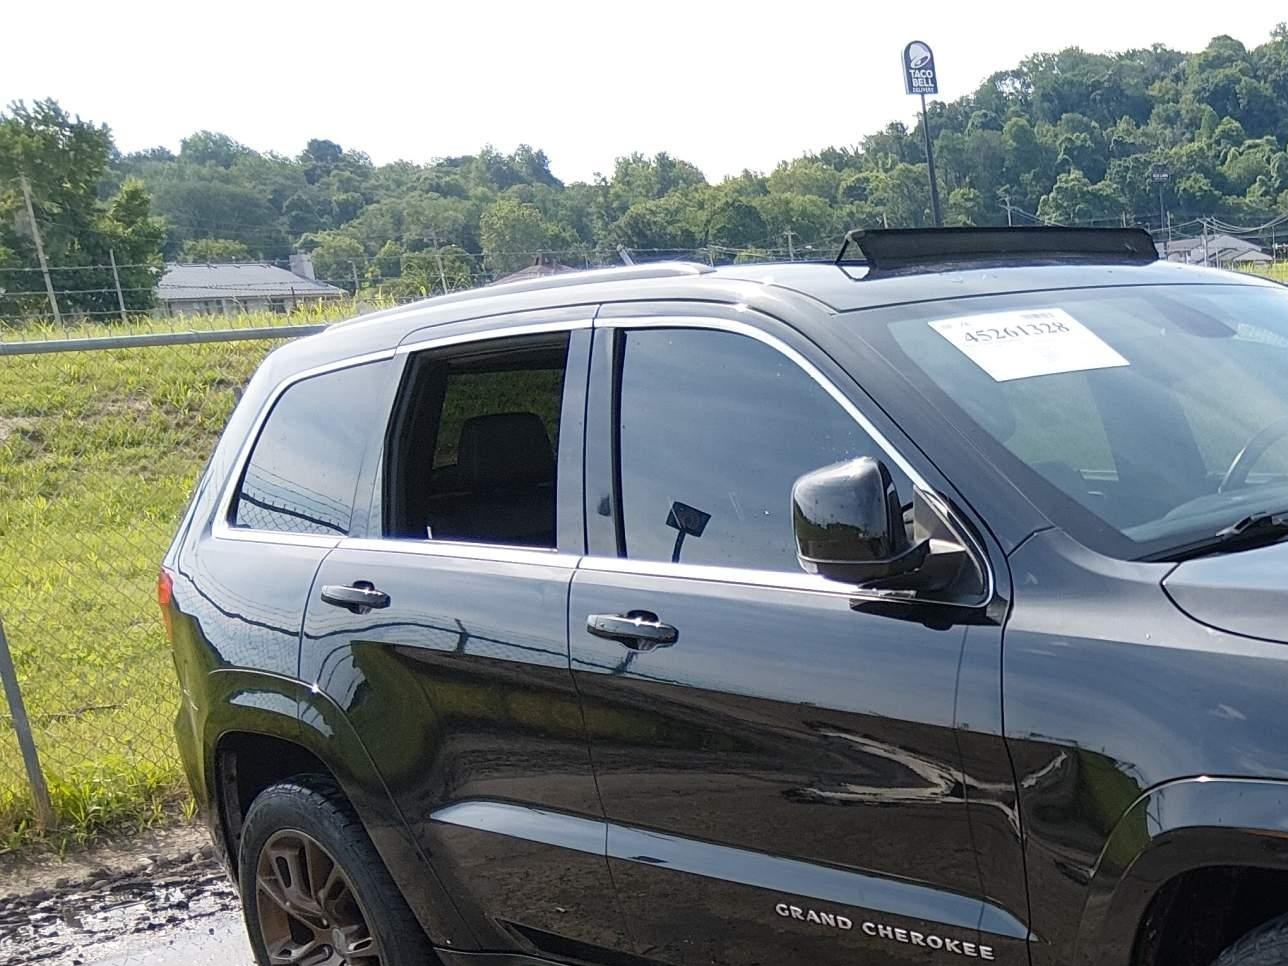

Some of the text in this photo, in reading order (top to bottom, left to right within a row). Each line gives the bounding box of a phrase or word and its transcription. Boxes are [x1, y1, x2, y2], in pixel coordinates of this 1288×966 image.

[909, 69, 933, 78] TACO
[912, 78, 935, 87] BELL
[964, 321, 1070, 343] 45261328
[775, 903, 996, 961] GRAND CHEROKEE
